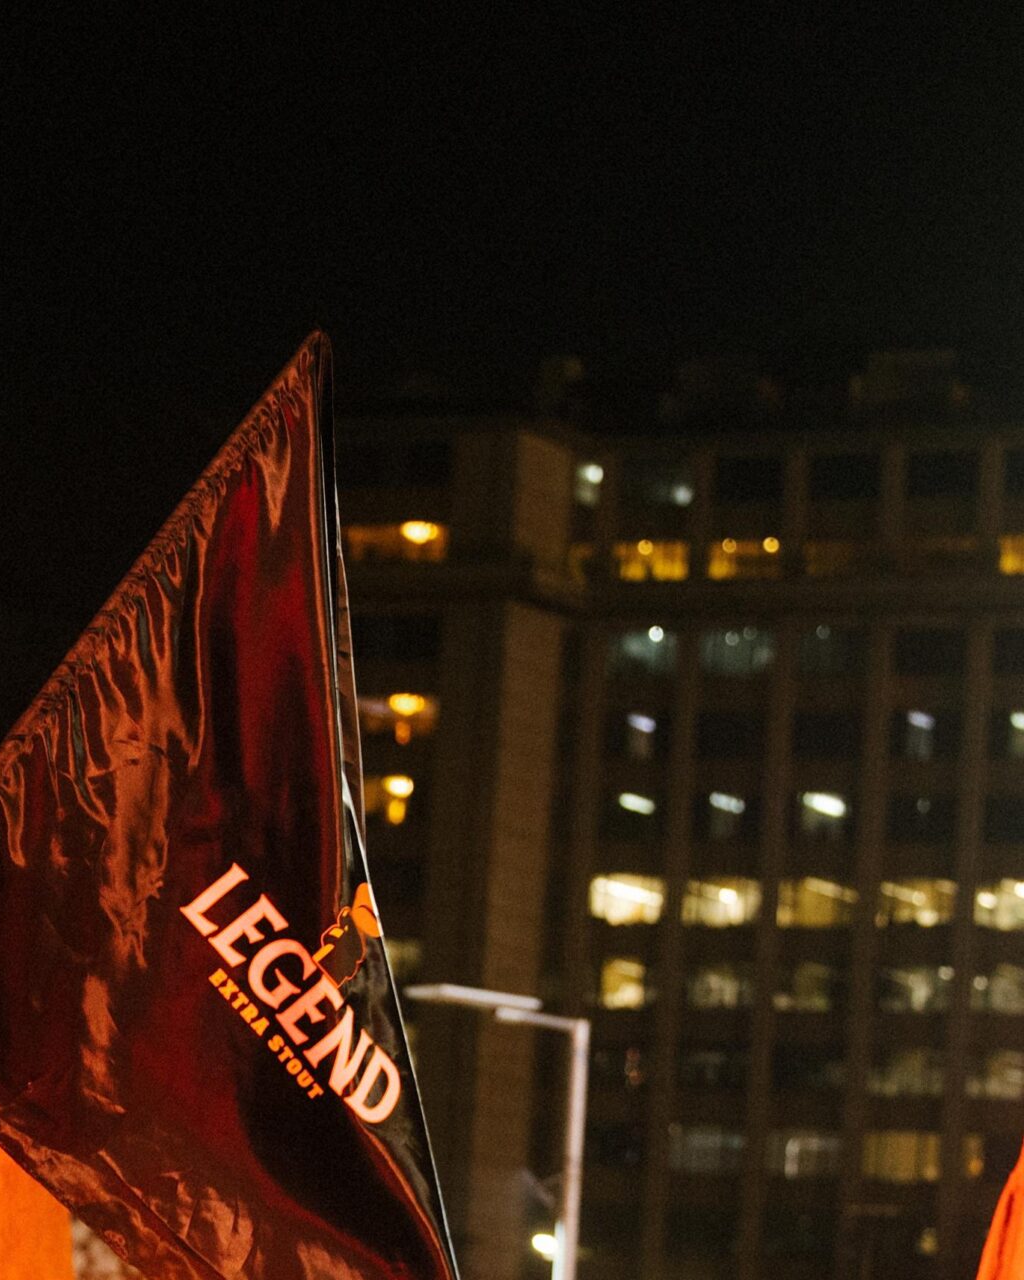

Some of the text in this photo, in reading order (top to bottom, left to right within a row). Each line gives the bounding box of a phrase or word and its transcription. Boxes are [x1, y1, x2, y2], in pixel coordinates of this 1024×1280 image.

[179, 862, 401, 1124] LEGEND
[208, 967, 324, 1100] EXTRA STOUT
